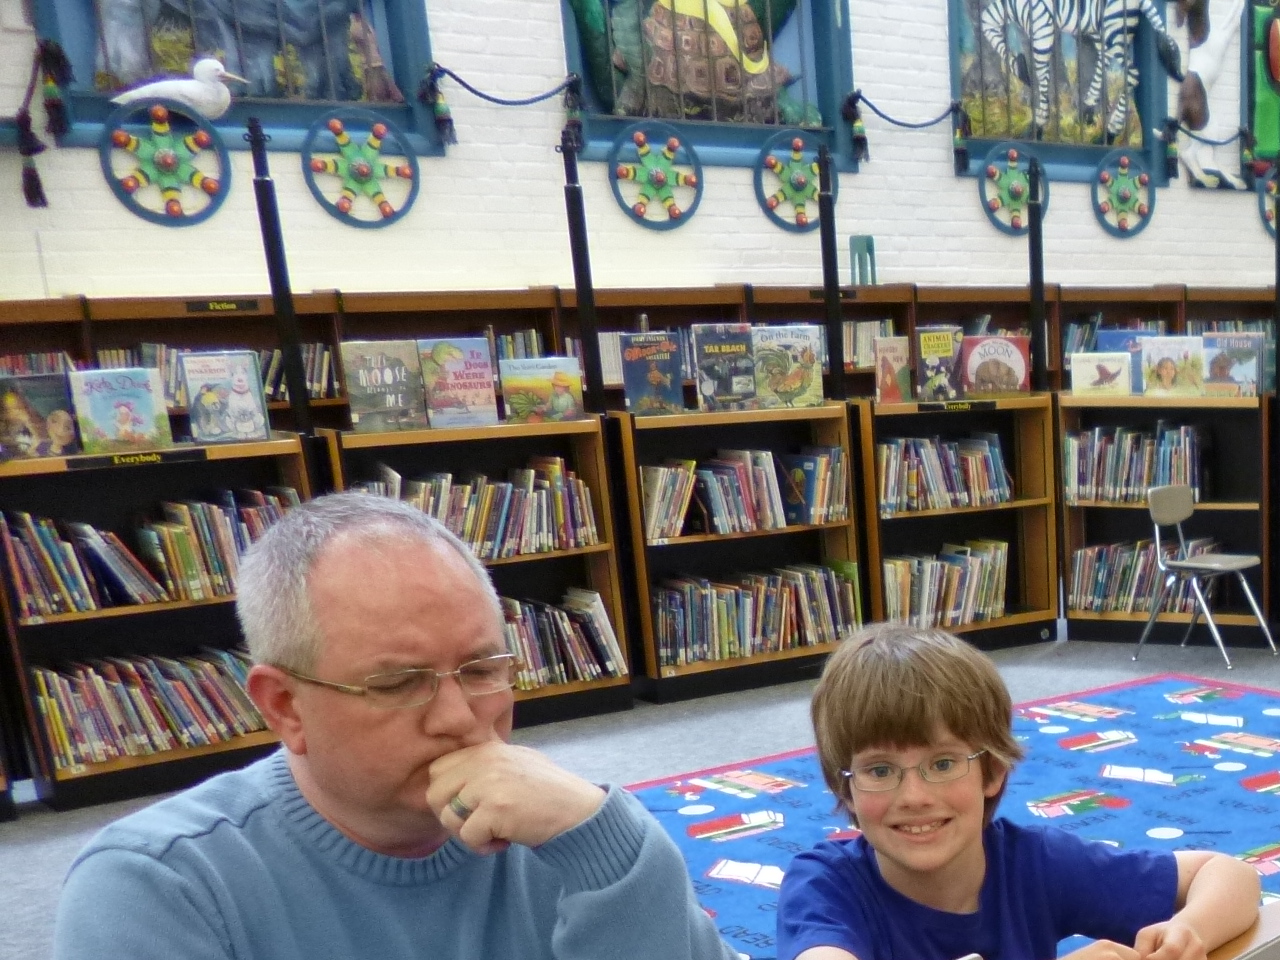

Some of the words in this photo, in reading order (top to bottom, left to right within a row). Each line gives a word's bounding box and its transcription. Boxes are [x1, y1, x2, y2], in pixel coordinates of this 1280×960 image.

[209, 302, 237, 311] Fiction
[761, 332, 774, 342] On
[790, 331, 811, 342] Farm
[1216, 338, 1228, 347] Old
[1229, 338, 1252, 347] House
[703, 345, 720, 353] TAR
[721, 344, 746, 353] BEACH
[978, 346, 1013, 359] MOON
[358, 366, 407, 387] MOOSE
[386, 393, 403, 407] ME
[113, 454, 162, 465] Everybody
